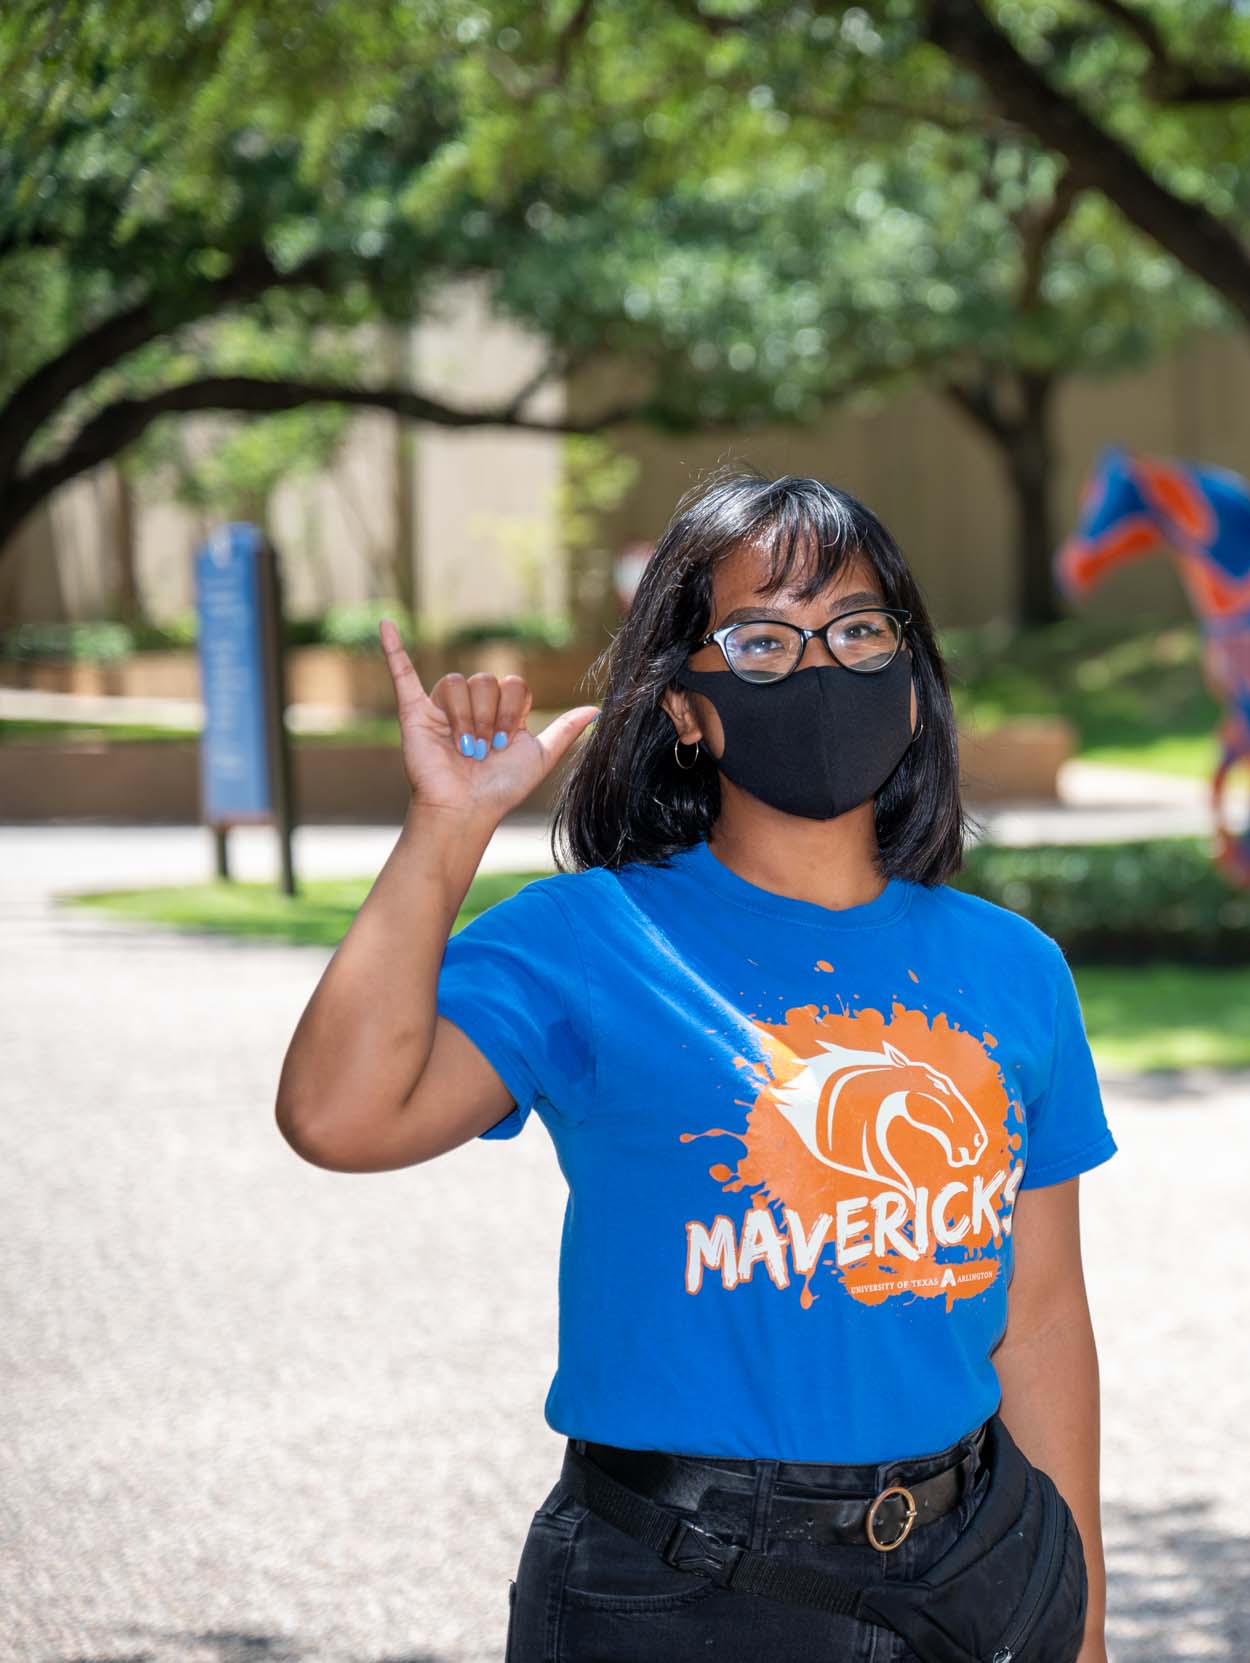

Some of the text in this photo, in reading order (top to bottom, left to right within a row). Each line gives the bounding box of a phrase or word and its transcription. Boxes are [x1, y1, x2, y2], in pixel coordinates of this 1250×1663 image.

[685, 1166, 1023, 1293] MAVERICKS
[851, 1282, 895, 1295] UNIVERSITY
[897, 1280, 908, 1289] OF
[911, 1278, 938, 1288] TEXAS
[957, 1271, 993, 1283] ARLINGTON
